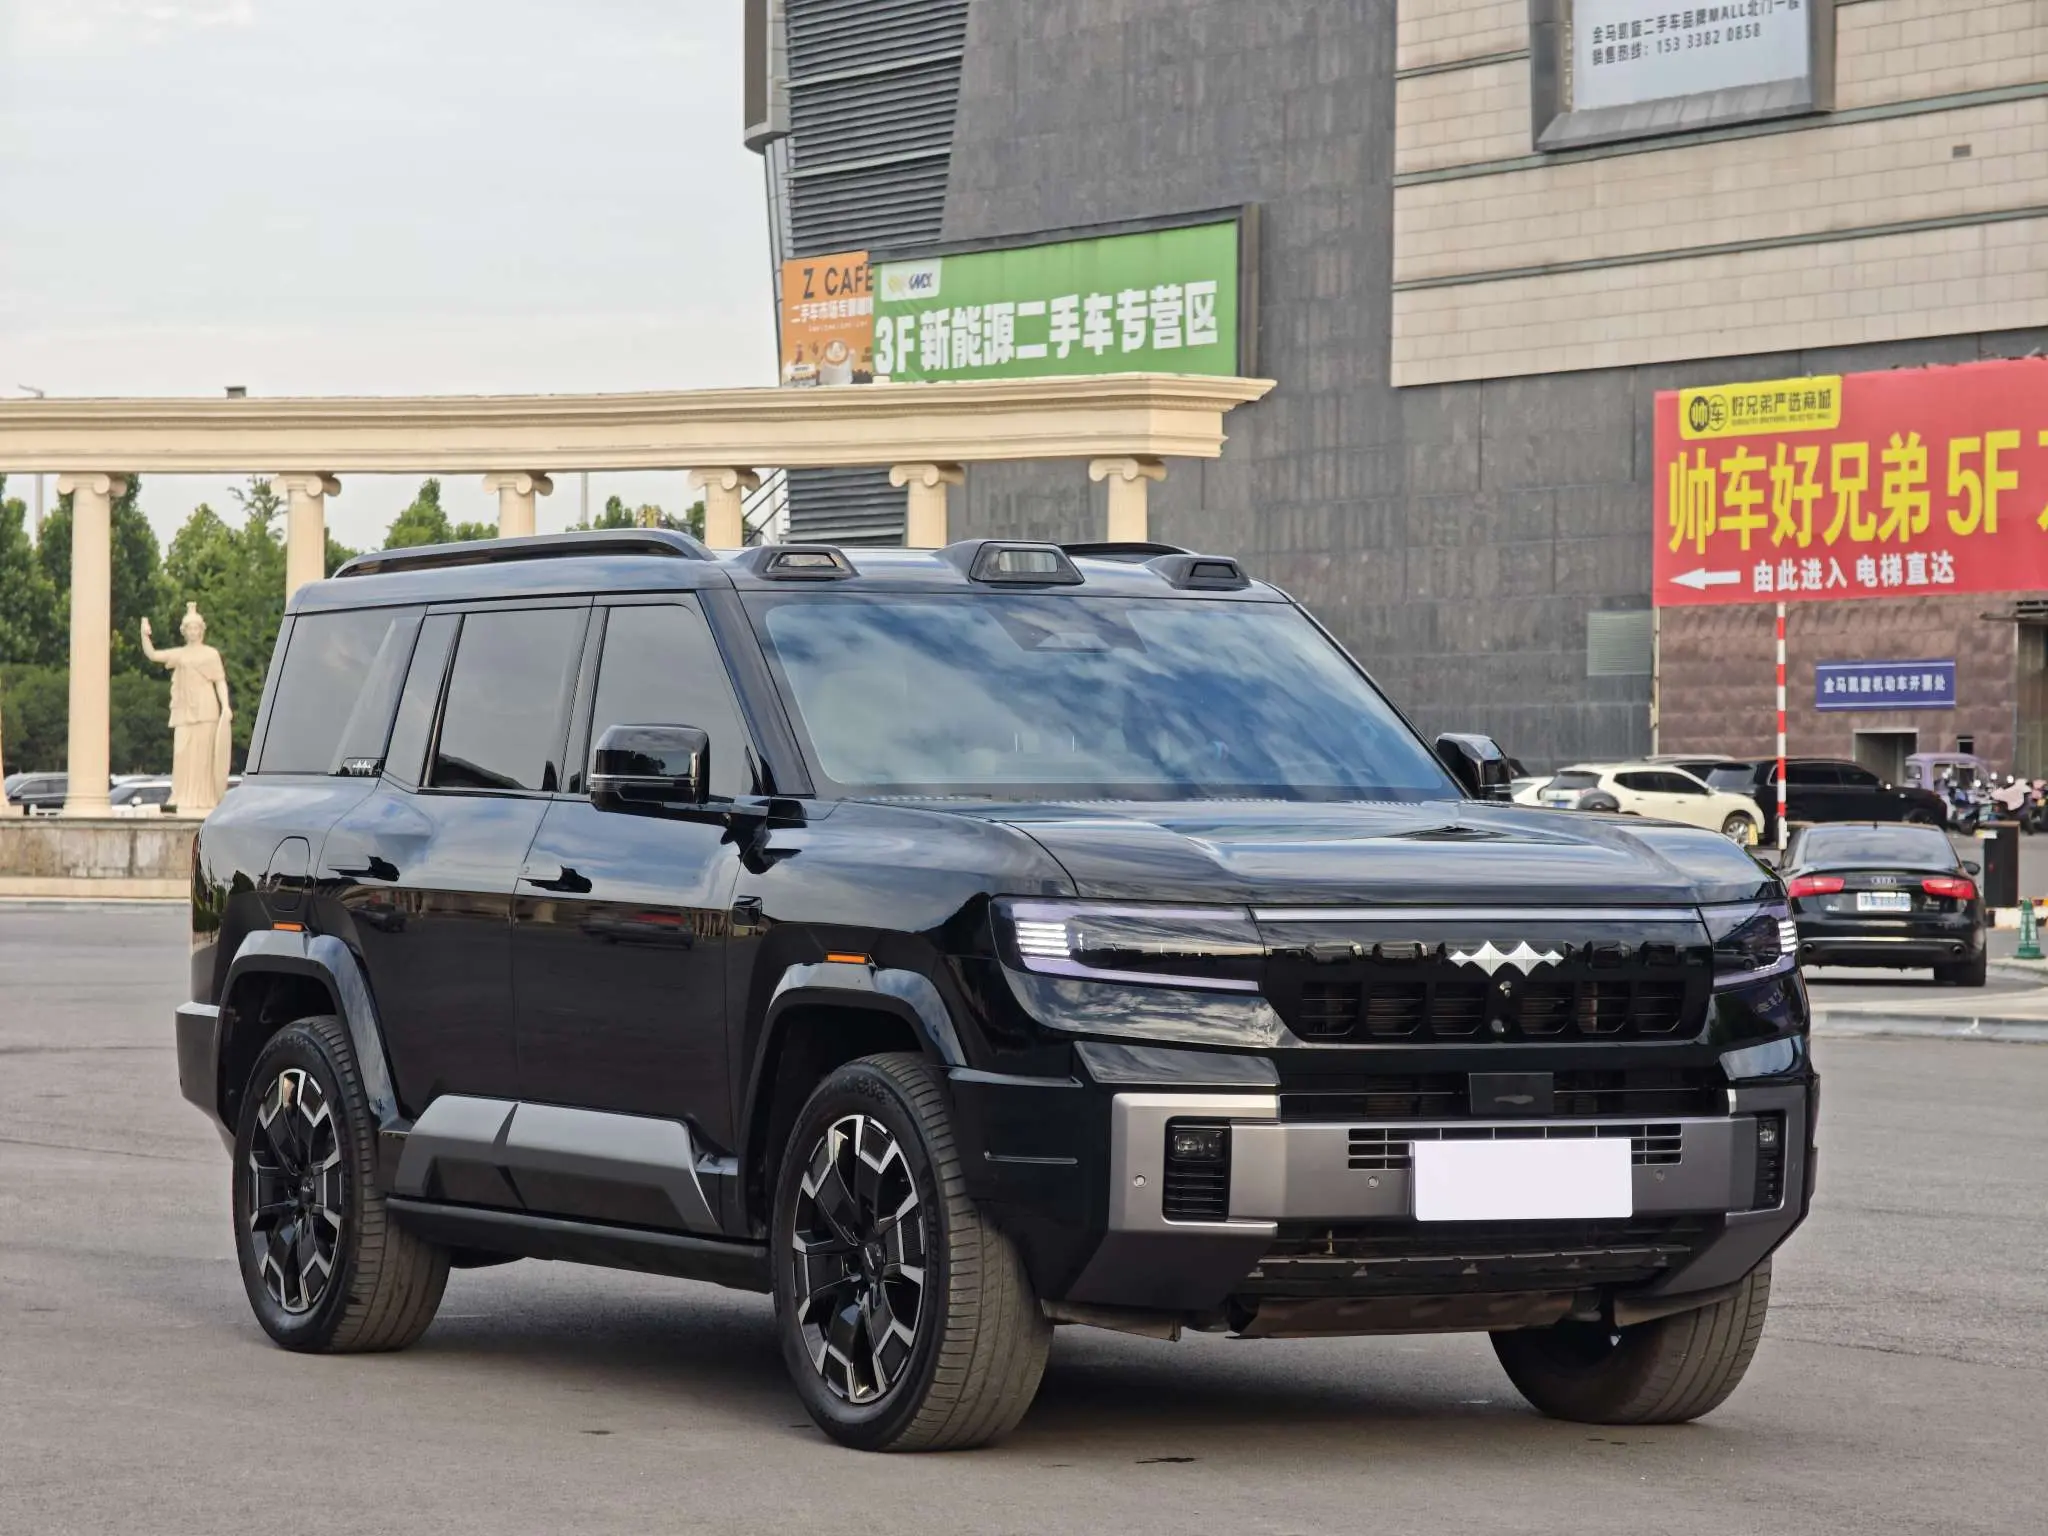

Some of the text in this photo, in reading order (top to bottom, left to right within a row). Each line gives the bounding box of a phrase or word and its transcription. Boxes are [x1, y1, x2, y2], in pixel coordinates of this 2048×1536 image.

[1656, 37, 1681, 55] 153
[1687, 30, 1721, 50] 3382
[803, 267, 815, 299] Z
[1668, 431, 1931, 555] 帅车好兄弟
[1946, 429, 2021, 536] 5F
[1753, 550, 1956, 593] 由此进入 电梯直达
